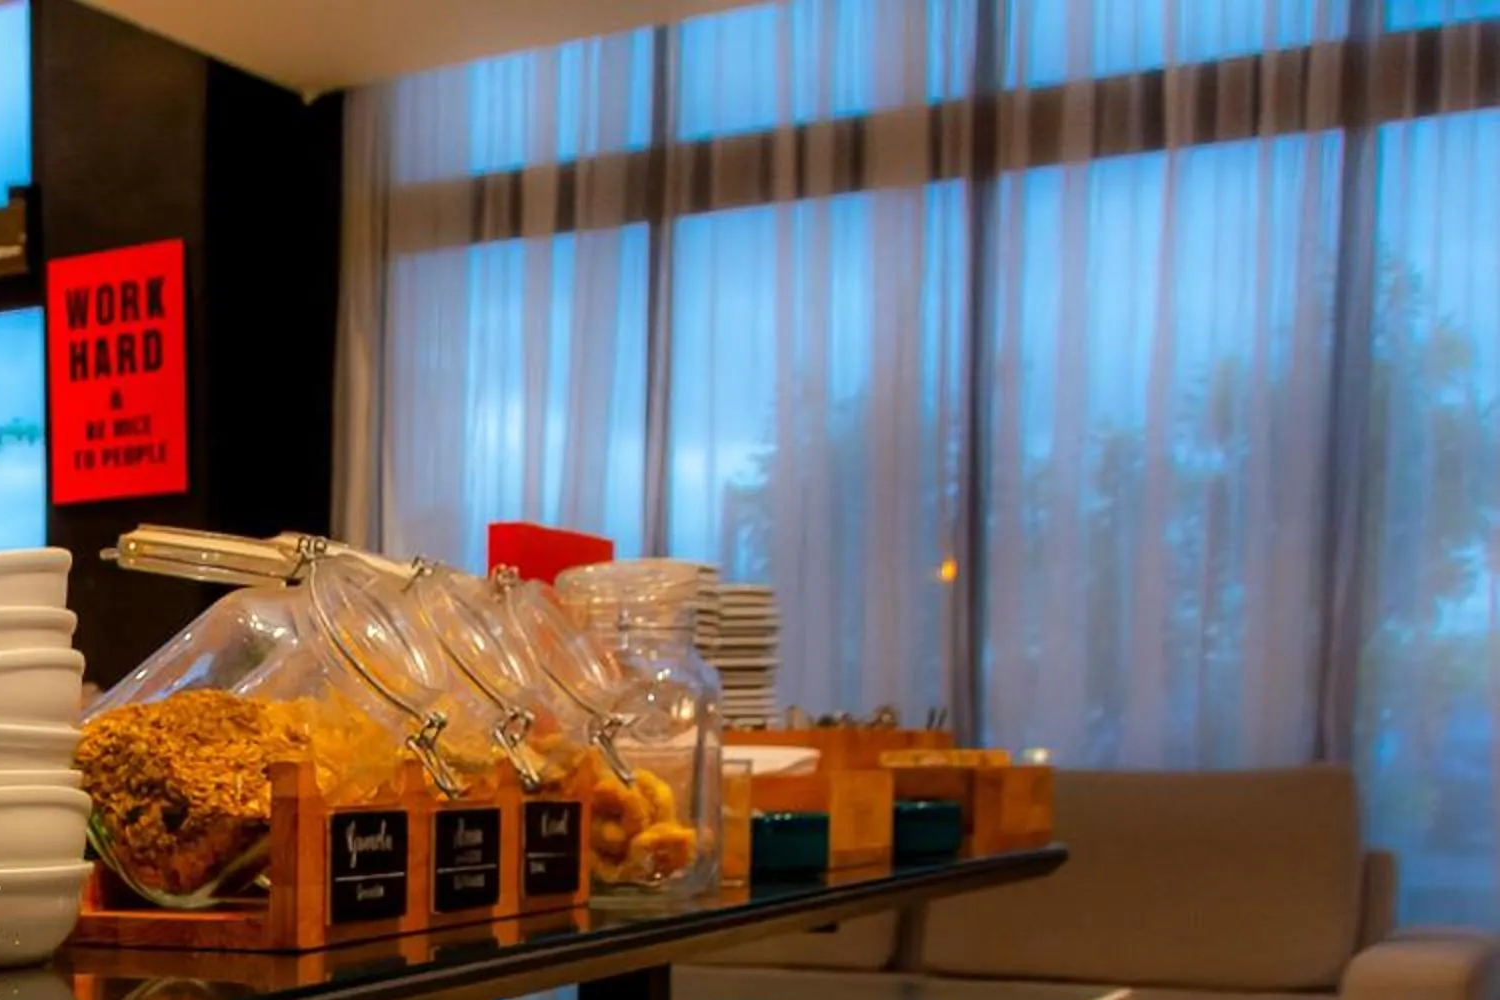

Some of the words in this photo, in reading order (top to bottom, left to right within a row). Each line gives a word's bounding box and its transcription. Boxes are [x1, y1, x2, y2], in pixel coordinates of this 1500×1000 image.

[65, 276, 165, 330] WORK
[69, 328, 163, 382] HARD
[86, 420, 105, 441] BE
[74, 449, 95, 470] TO
[101, 441, 167, 468] PEOPLE
